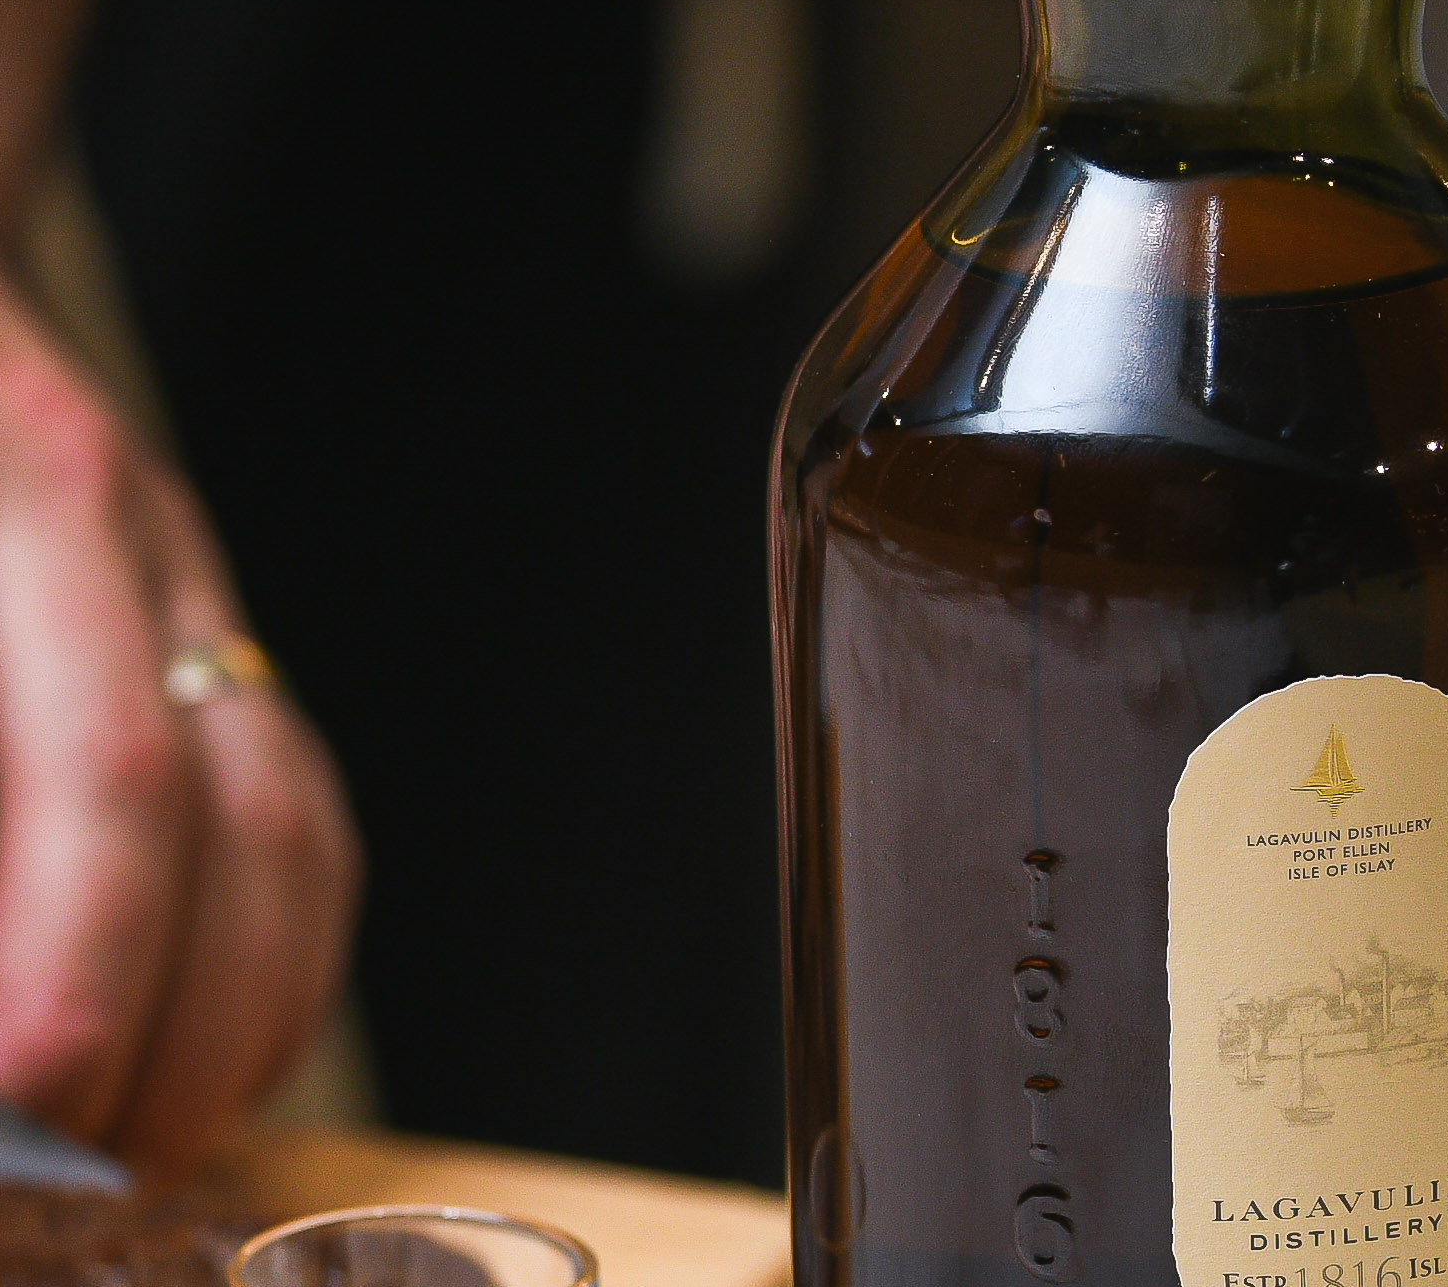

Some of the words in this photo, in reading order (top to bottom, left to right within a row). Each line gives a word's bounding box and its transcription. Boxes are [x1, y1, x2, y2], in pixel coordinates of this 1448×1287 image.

[1247, 829, 1341, 847] LAGAVULIN
[1348, 817, 1432, 840] DISTILLERY
[1293, 848, 1336, 862] PORT
[1343, 842, 1390, 858] ELLEN
[1288, 867, 1320, 880] ISLE
[1326, 864, 1348, 877] OF
[1354, 859, 1395, 874] ISLAY
[1250, 1213, 1443, 1251] DISTILLERY
